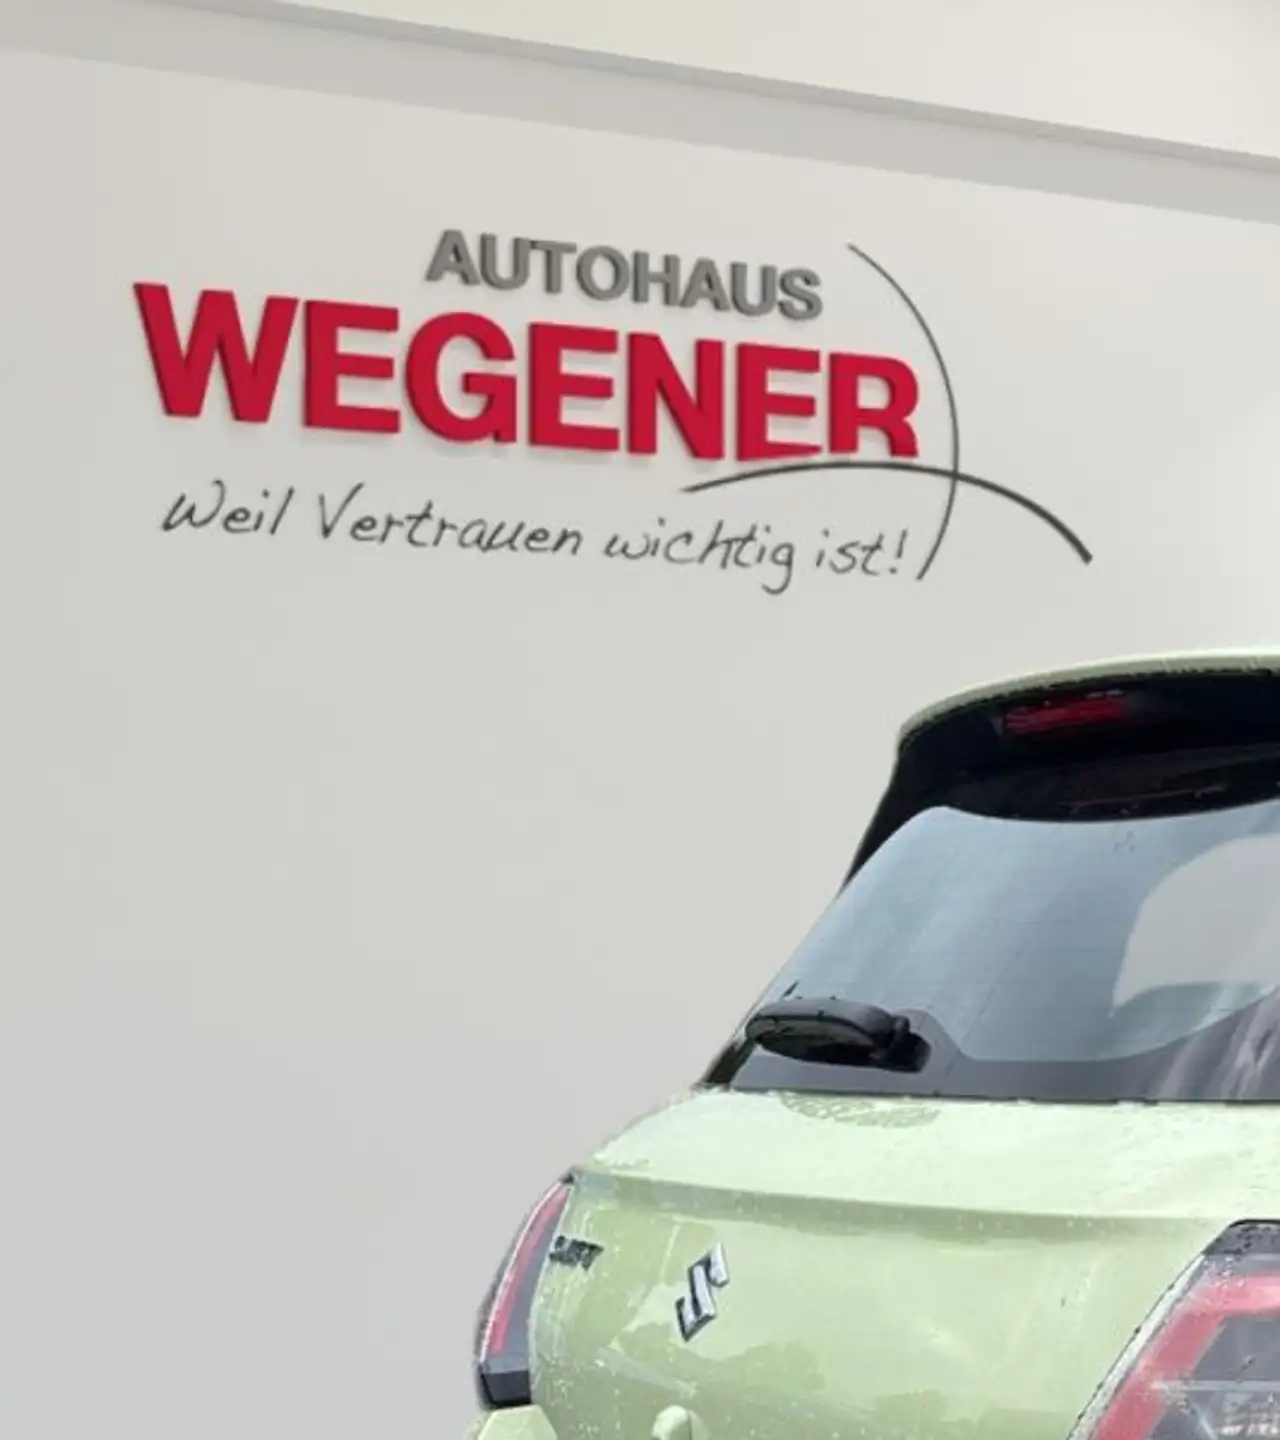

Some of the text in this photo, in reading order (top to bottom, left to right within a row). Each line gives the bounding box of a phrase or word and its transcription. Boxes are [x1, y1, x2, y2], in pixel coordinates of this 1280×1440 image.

[426, 230, 822, 321] AUTOHAUS
[134, 281, 920, 461] WEGENER
[162, 479, 907, 596] Weil Vertrauen wichtig ist!
